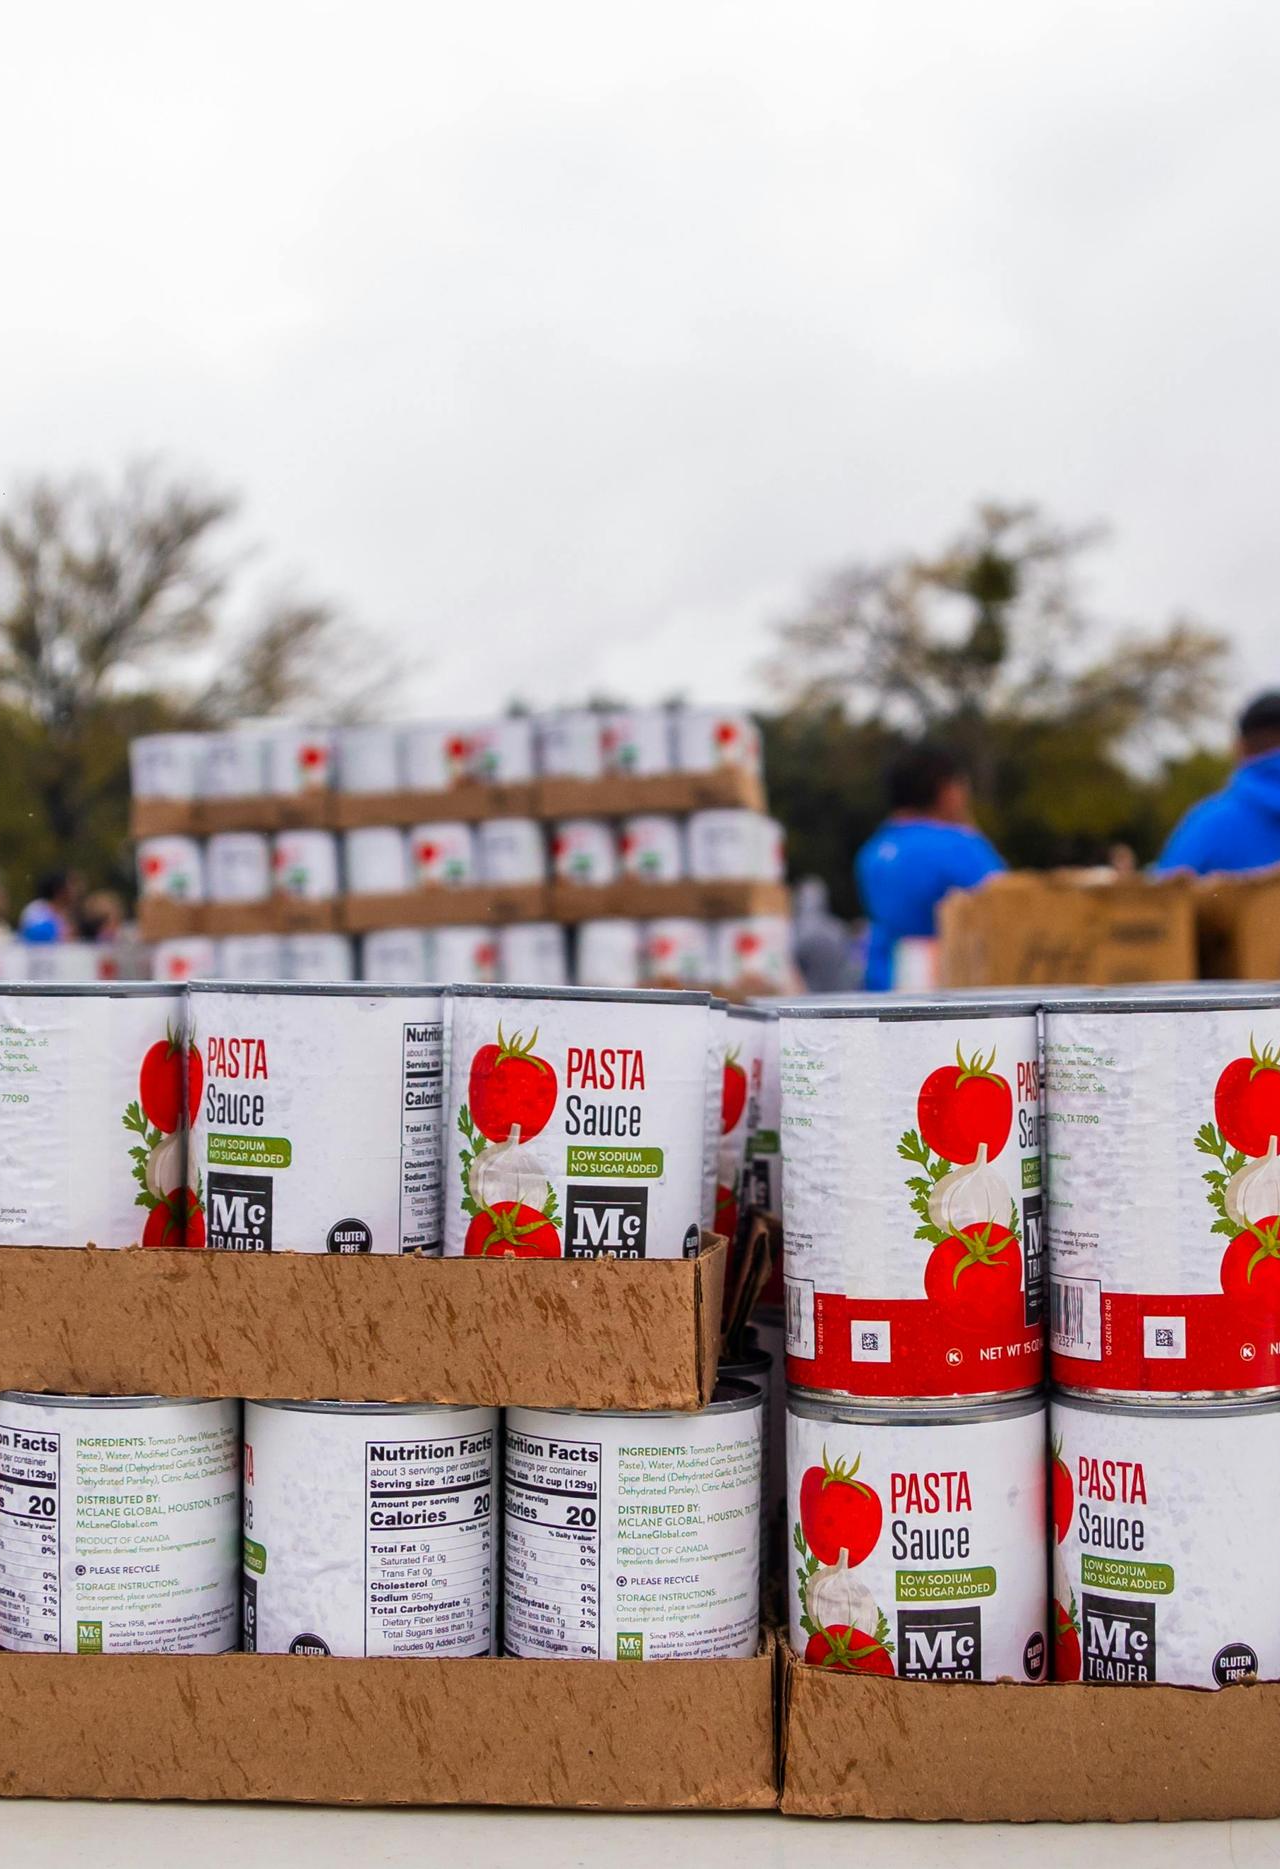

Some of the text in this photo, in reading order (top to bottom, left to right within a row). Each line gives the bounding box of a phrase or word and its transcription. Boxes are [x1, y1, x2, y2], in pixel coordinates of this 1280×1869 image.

[208, 1037, 268, 1083] PASTA
[567, 1048, 646, 1093] PASTA
[207, 1083, 264, 1126] Sauce
[565, 1095, 642, 1139] Sauce
[210, 1138, 266, 1151] LOW SODIUM
[209, 1149, 284, 1165] NO SUGAR ADDED
[572, 1150, 642, 1161] LOW SODIUM
[571, 1162, 658, 1174] NO SUGAR ADDED
[334, 1231, 366, 1243] GLUTEN
[340, 1244, 360, 1253] FREE
[980, 1344, 1021, 1361] NET WT
[14, 1433, 58, 1453] Facts
[76, 1438, 146, 1447] INGREDIENTS:
[370, 1437, 492, 1462] Nutrition Facts
[549, 1443, 599, 1463] Facts
[618, 1447, 688, 1457] INGREDIENTS:
[27, 1468, 56, 1481] (129g)
[370, 1475, 470, 1489] Serving size 1/2 cup
[1079, 1456, 1148, 1506] PASTA
[565, 1479, 597, 1491] (129g)
[76, 1494, 161, 1505] DISTRIBUTED BY:
[891, 1471, 972, 1515] PASTA
[28, 1495, 56, 1517] 20
[76, 1499, 213, 1518] MCLANE GLOBAL, HOUSTON,
[370, 1493, 490, 1526] Calories 20
[618, 1504, 701, 1515] DISTRIBUTED BY:
[566, 1506, 596, 1528] 20
[618, 1518, 662, 1528] MCLANE
[665, 1516, 705, 1527] GLOBAL,
[76, 1520, 158, 1530] McLaneGlobal.com
[1079, 1503, 1145, 1552] Sauce
[618, 1530, 698, 1541] McLaneGlobal.com
[891, 1519, 970, 1561] Sauce
[1084, 1559, 1147, 1577] LOW SODIUM
[631, 1575, 700, 1586] PLEASE RECYCLE
[900, 1573, 972, 1586] LOW SODIUM
[1084, 1572, 1167, 1591] NO SUGAR ADDED
[617, 1593, 657, 1602] STORAGE
[900, 1584, 990, 1598] NO SUGAR ADDED
[1088, 1656, 1148, 1682] TRADER
[1220, 1656, 1252, 1669] GLUTEN
